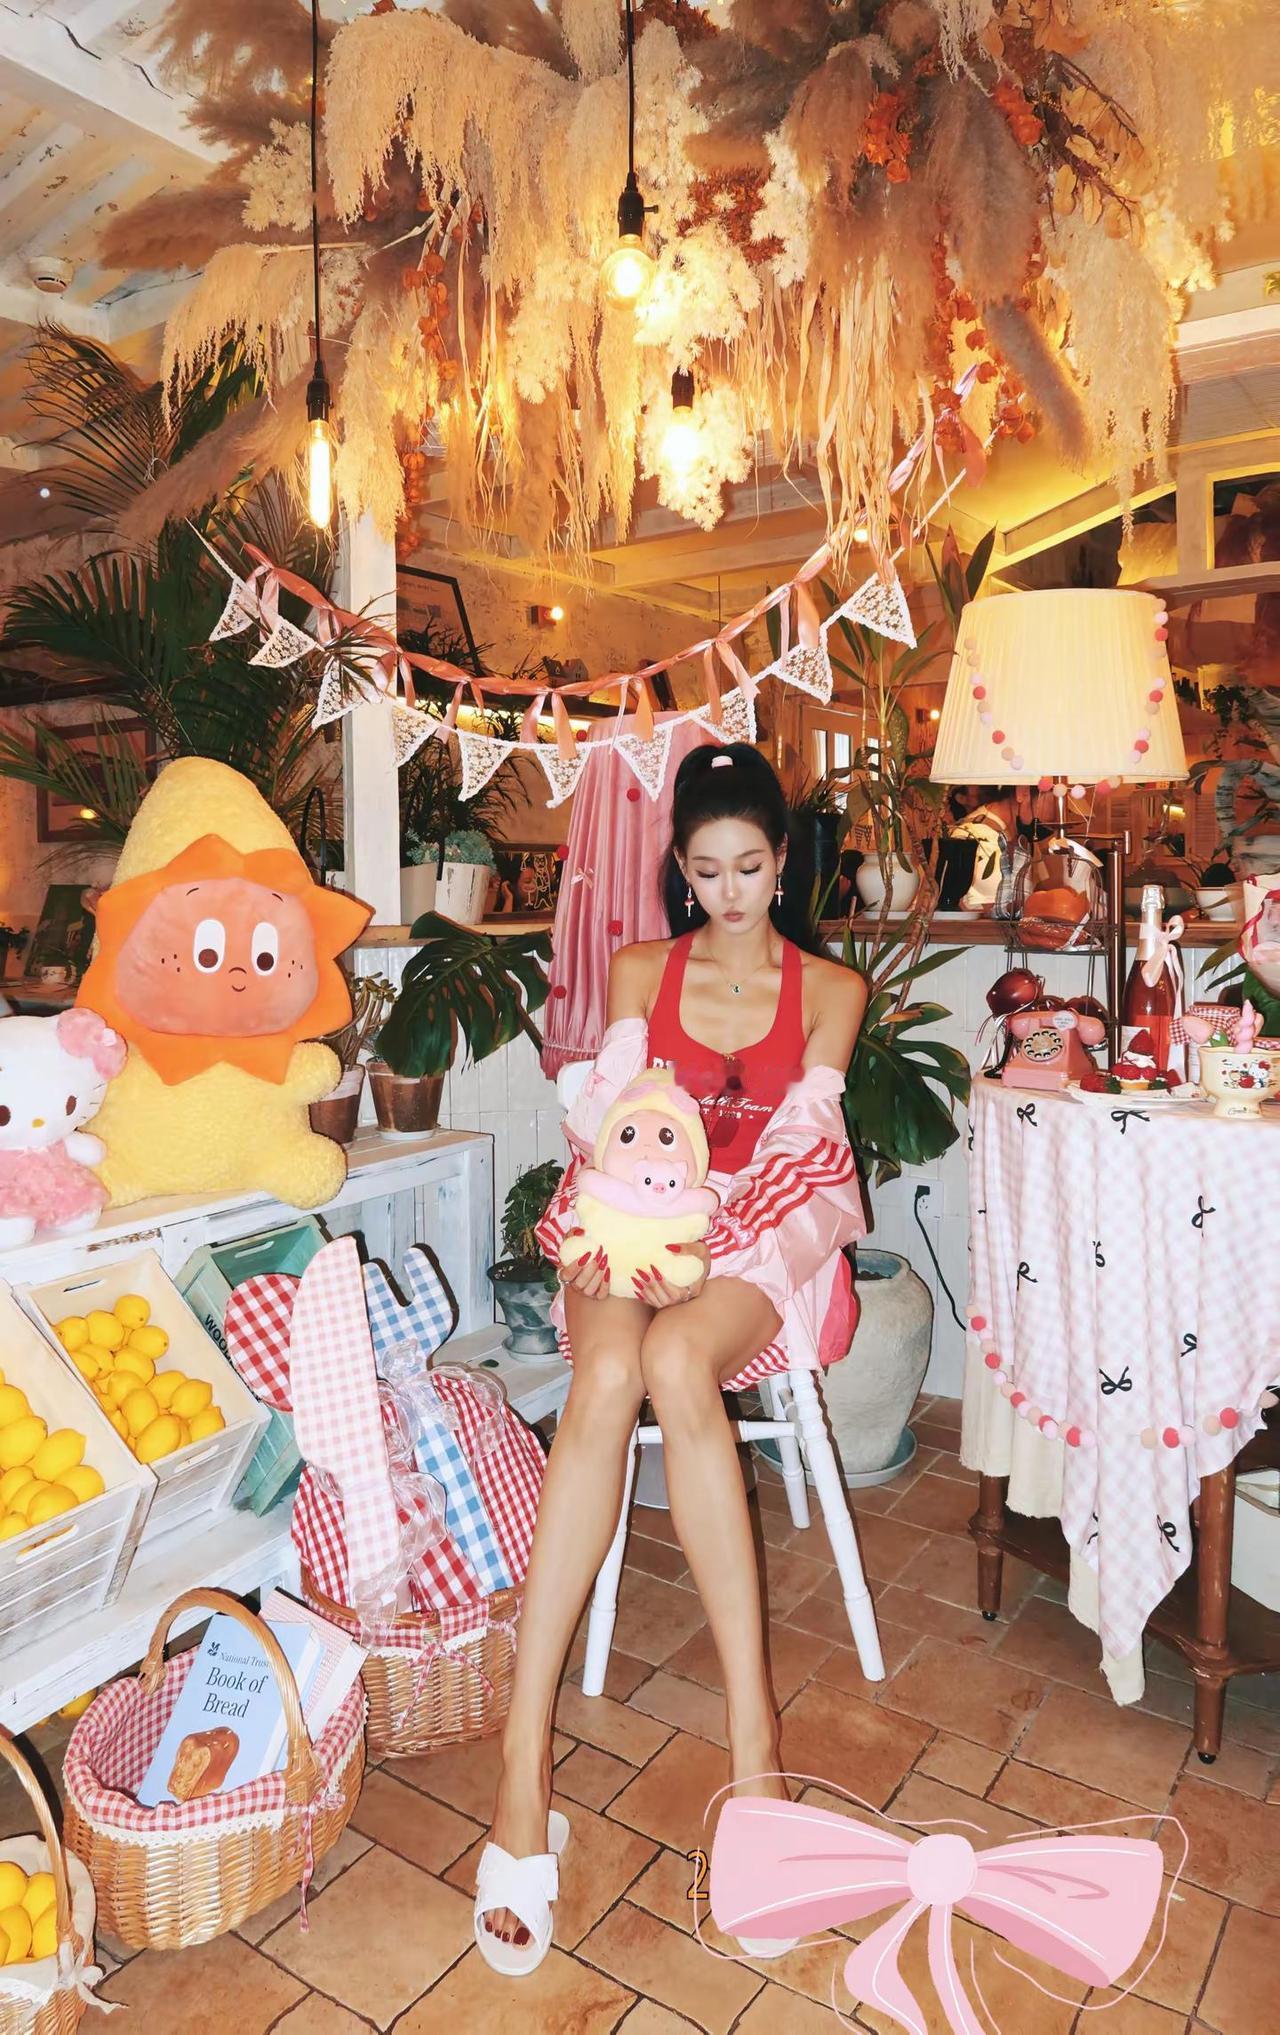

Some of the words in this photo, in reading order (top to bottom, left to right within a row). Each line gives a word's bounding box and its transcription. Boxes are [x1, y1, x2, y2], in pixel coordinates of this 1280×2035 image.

[732, 1097, 773, 1113] Team
[220, 1652, 250, 1665] National
[206, 1667, 247, 1690] Book
[248, 1675, 269, 1694] of
[202, 1692, 250, 1718] Bread
